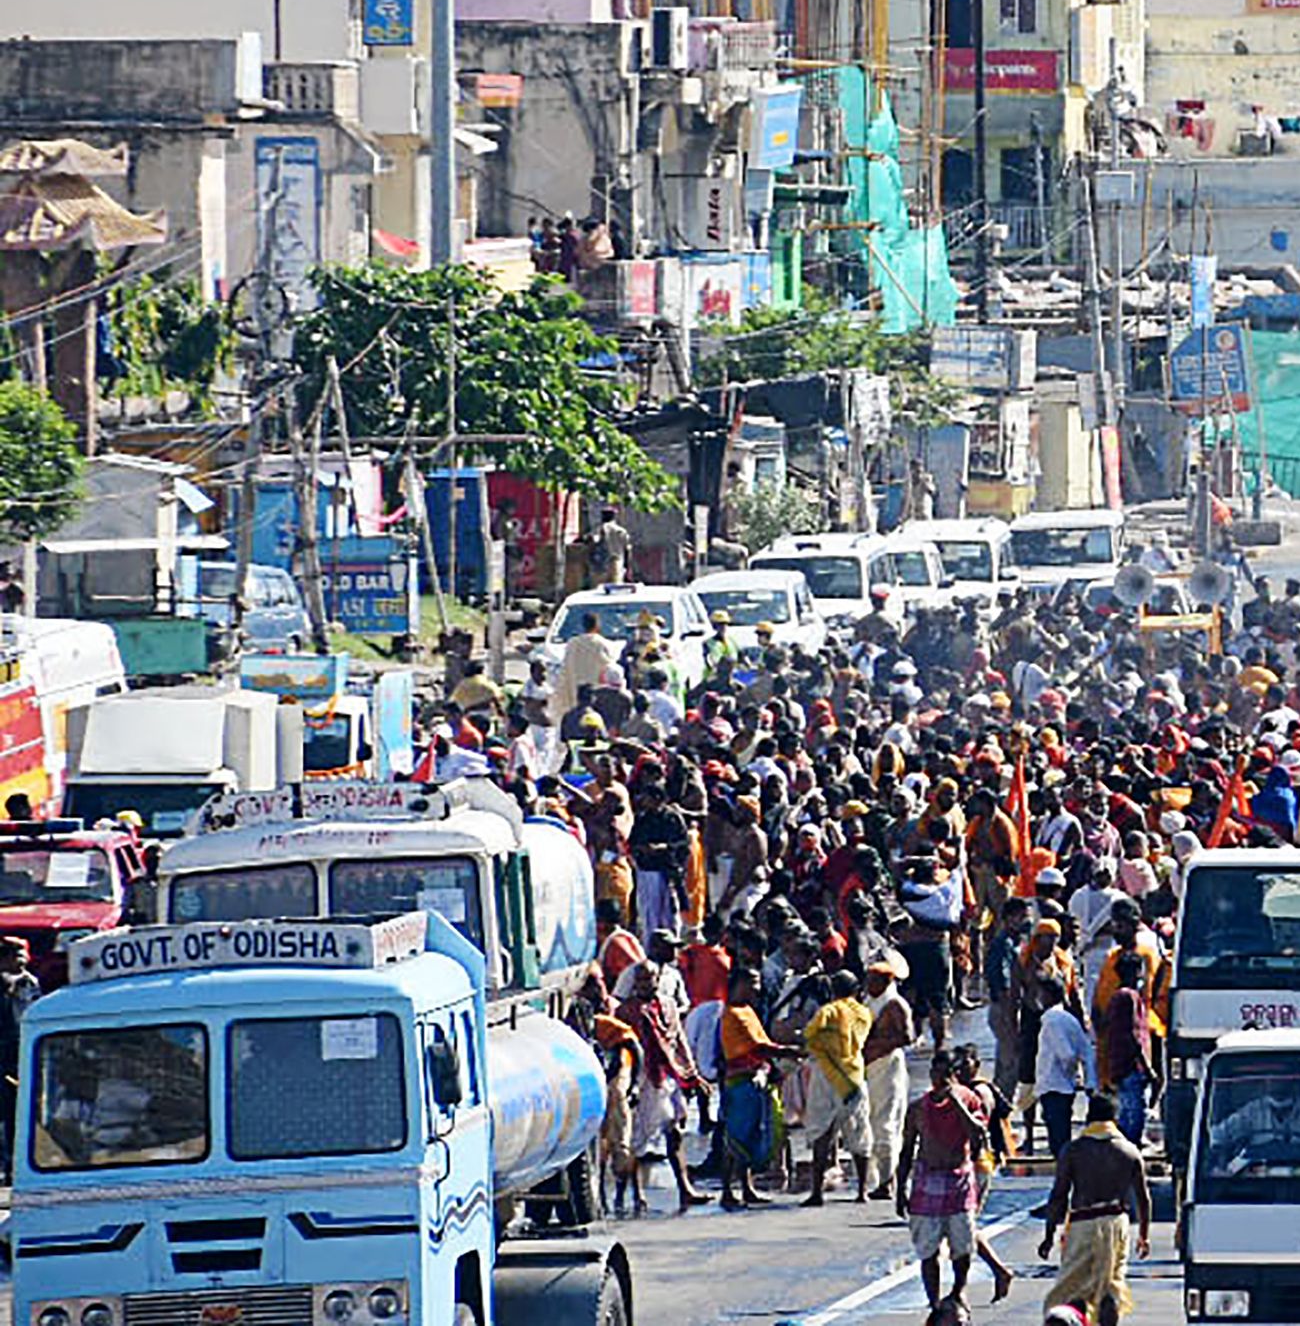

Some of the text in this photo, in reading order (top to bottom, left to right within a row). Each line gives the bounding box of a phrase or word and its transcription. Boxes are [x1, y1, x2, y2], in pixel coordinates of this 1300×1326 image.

[356, 575, 389, 591] BAR
[101, 930, 339, 971] GOVT. OF ODISHA
